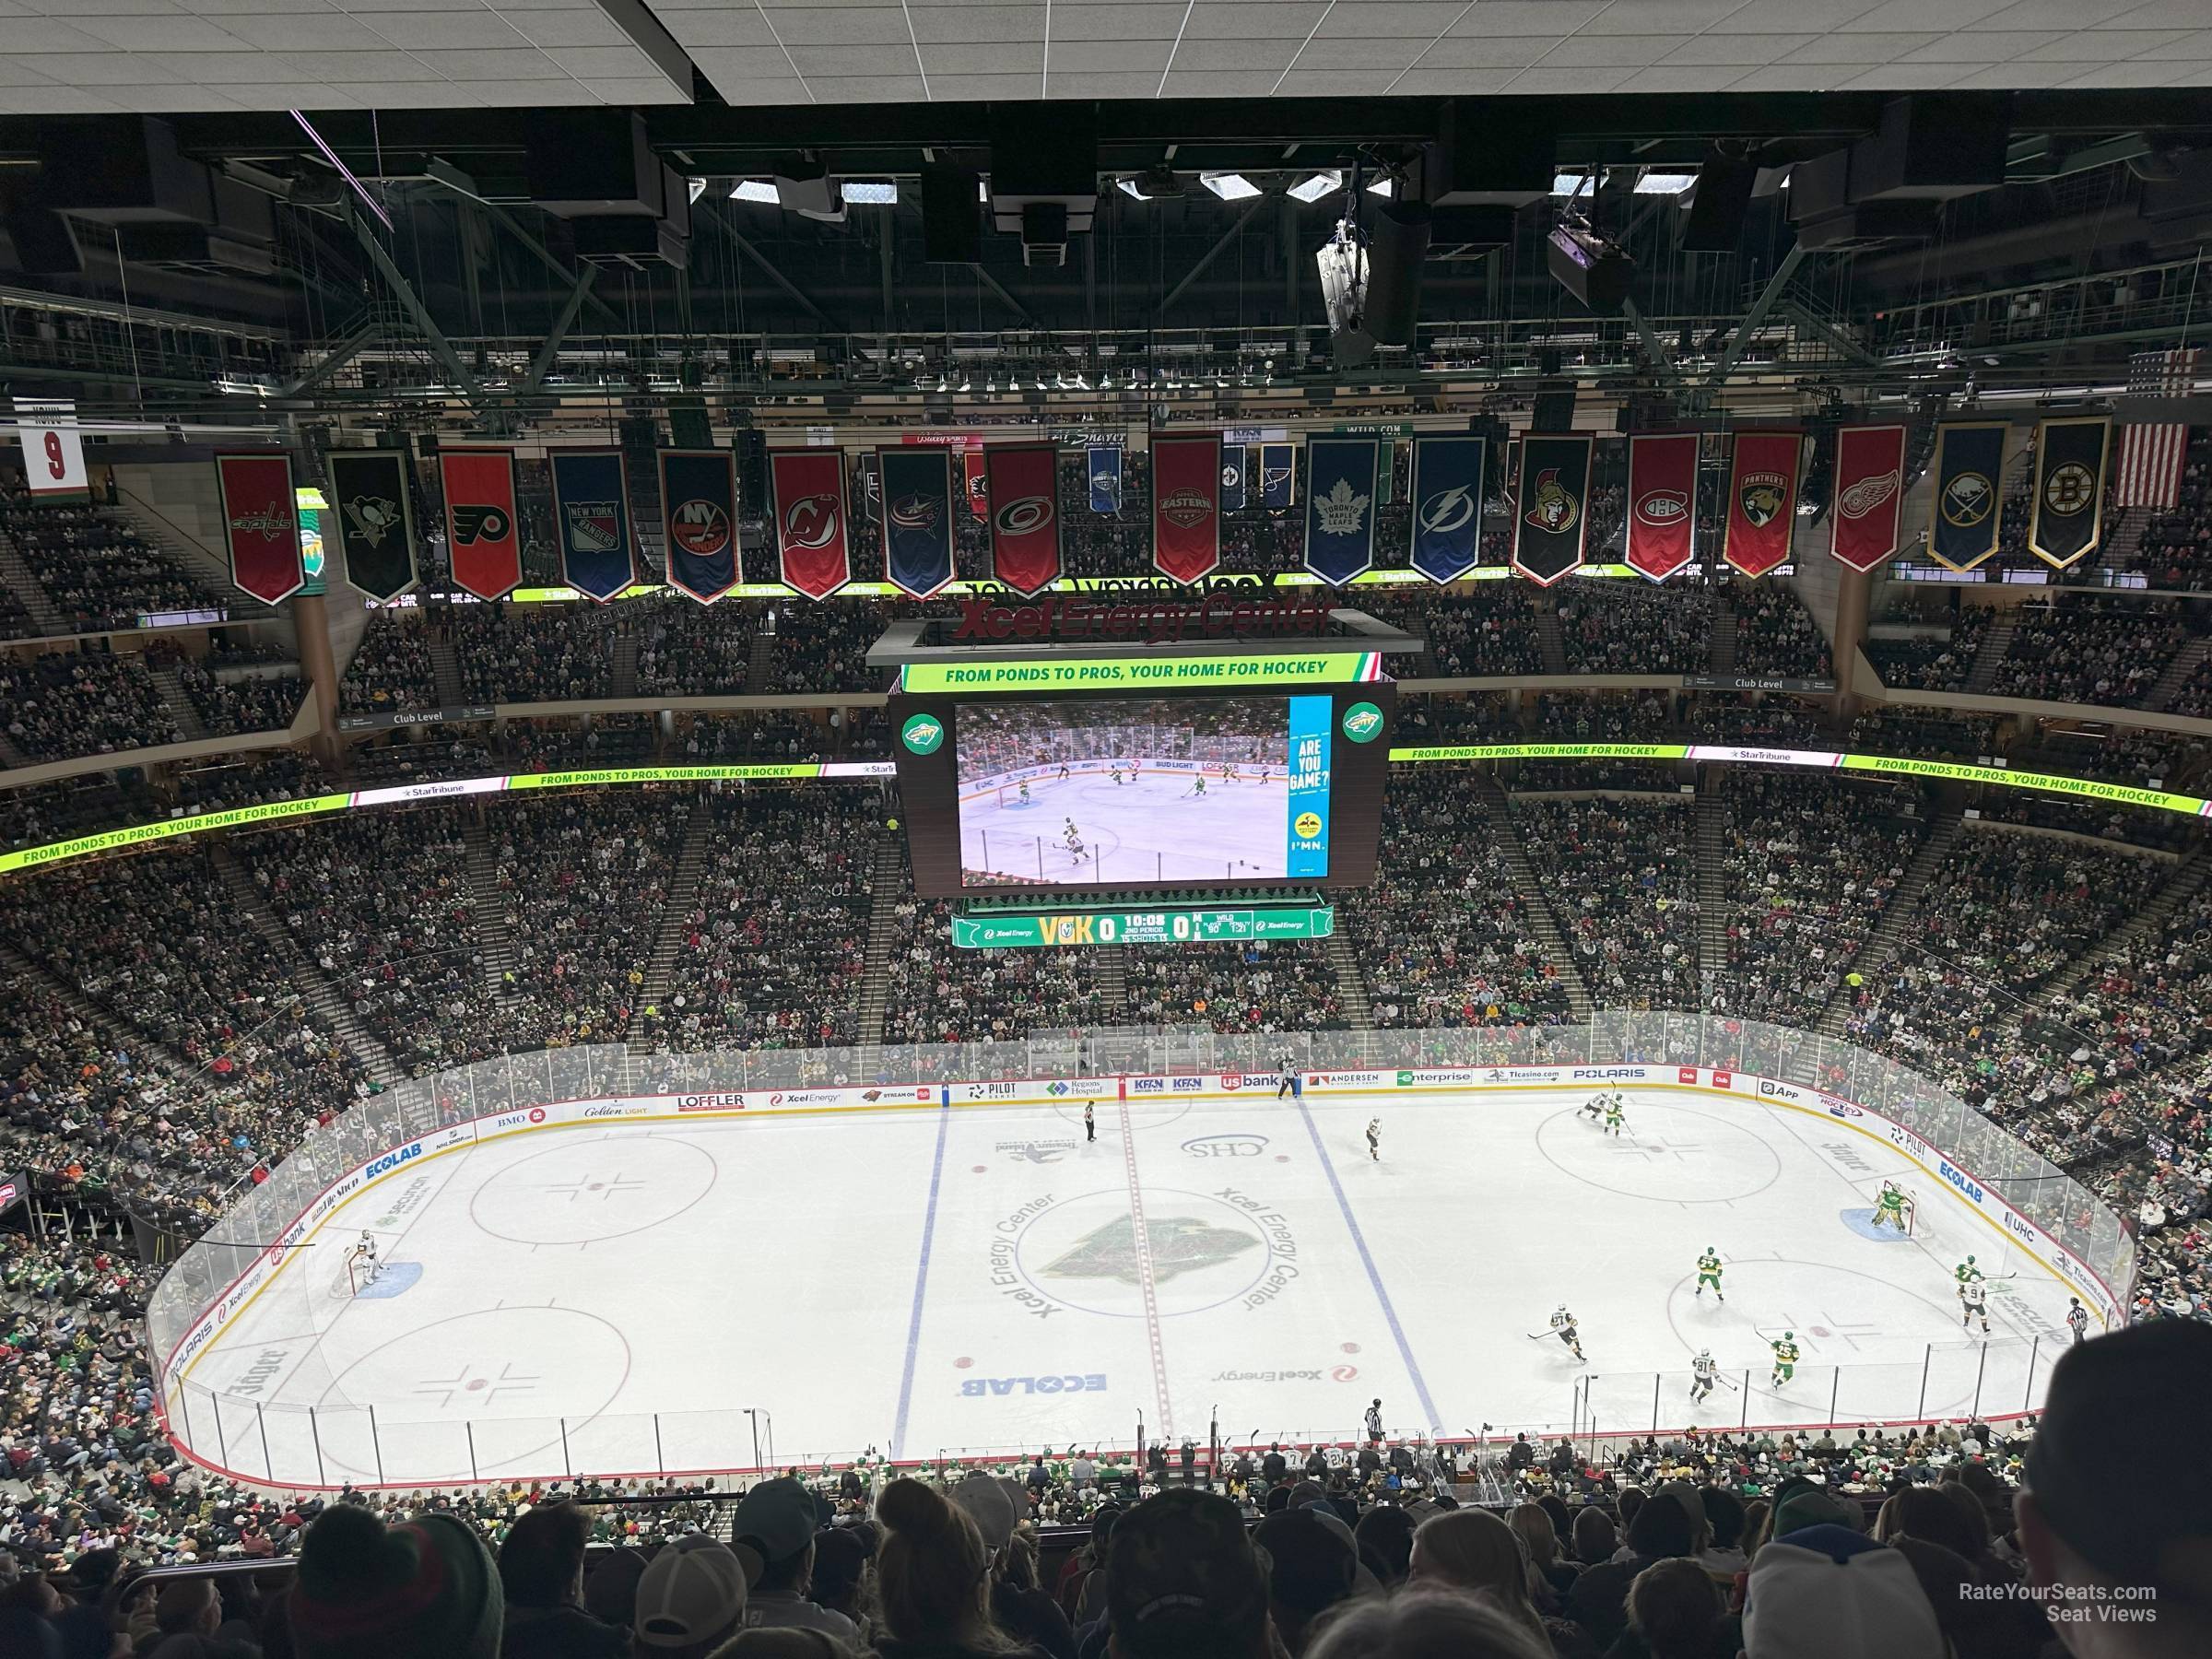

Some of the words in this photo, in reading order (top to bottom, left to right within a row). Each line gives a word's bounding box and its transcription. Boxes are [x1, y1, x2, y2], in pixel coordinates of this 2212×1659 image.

[44, 431, 65, 479] 9
[1744, 473, 1784, 487] PANTHERS
[571, 507, 589, 516] NEW
[592, 506, 613, 516] YORK
[1161, 498, 1211, 510] EASTERN
[1324, 505, 1359, 514] TORONTO
[578, 519, 617, 547] RANGERS
[953, 598, 1053, 638] Xcel
[1059, 596, 1198, 644] Energy
[1200, 593, 1338, 633] Center
[946, 669, 991, 682] FROM
[995, 667, 1050, 681] PONDS
[1054, 667, 1076, 679] TO
[1079, 666, 1124, 680] PROS,
[1130, 665, 1173, 677] YOUR
[1177, 664, 1225, 677] HOME
[1229, 663, 1259, 676] FOR
[1263, 661, 1328, 674] HOCKEY
[1735, 678, 1757, 688] Club
[1759, 678, 1783, 689] Level
[394, 714, 416, 726] Club
[418, 712, 442, 723] Level
[1299, 739, 1321, 758] ARE
[1412, 749, 1441, 758] FROM
[1443, 748, 1477, 758] PONDS
[1480, 747, 1492, 756] TO
[1495, 747, 1524, 756] PROS,
[1527, 747, 1555, 755] YOUR
[1558, 747, 1589, 755] HOME
[1591, 747, 1612, 755] FOR
[1614, 747, 1658, 756] HOCKEY
[1740, 750, 1790, 760] StarTribune
[1299, 756, 1321, 773] YOU
[541, 775, 571, 785] FROM
[575, 772, 611, 782] PONDS
[615, 771, 629, 781] TO
[631, 771, 662, 780] PROS,
[665, 770, 694, 778] YOUR
[696, 769, 727, 777] HOME
[730, 769, 749, 777] FOR
[751, 767, 794, 776] HOCKEY
[1290, 771, 1329, 791] GAME?
[1876, 759, 1910, 771] FROM
[1912, 763, 1953, 776] PONDS
[1957, 767, 1971, 777] TO
[1974, 770, 2010, 782] PROS,
[2014, 774, 2047, 787] YOUR
[2050, 779, 2088, 793] HOME
[2090, 785, 2114, 797] FOR
[2117, 790, 2170, 806] HOCKEY
[412, 785, 465, 796] StarTribune
[24, 847, 60, 864] FROM
[65, 837, 106, 855] PONDS
[110, 833, 125, 844] TO
[129, 826, 165, 841] PROS,
[168, 820, 202, 833] YOUR
[206, 812, 241, 826] HOME
[245, 807, 267, 820] FOR
[271, 800, 320, 816] HOCKEY
[1124, 914, 1165, 927] 10:08
[1173, 916, 1189, 938] 0
[1283, 922, 1305, 930] Energy
[1012, 929, 1034, 937] Energy
[1039, 916, 1094, 945] VGK
[1100, 919, 1115, 941] 0
[1132, 935, 1157, 943] SHOTS
[1398, 1070, 1471, 1083] enterprise
[1574, 1069, 1645, 1078] POLARIS
[1715, 1076, 1729, 1084] Cub
[989, 1083, 1016, 1094] PILOT
[1135, 1079, 1163, 1089] KFAN
[1173, 1077, 1202, 1088] KFAN
[1222, 1077, 1241, 1088] us
[1243, 1075, 1278, 1086] bank
[1071, 1086, 1102, 1095] Hospital
[678, 1095, 744, 1108] LOFFLER
[787, 1095, 808, 1103] Xcel
[809, 1093, 838, 1104] Energy
[584, 1105, 622, 1118] Golden
[626, 1107, 648, 1115] LIGHT
[1820, 1099, 1857, 1114] HOCKEY
[498, 1114, 525, 1127] BMO
[1190, 1143, 1263, 1158] CHS
[1907, 1134, 1926, 1156] PILOT
[366, 1144, 422, 1180] ECOLAB
[1940, 1161, 1983, 1204] ECOLAB
[1213, 1187, 1271, 1213] Xcel
[996, 1194, 1055, 1233] Center
[284, 1221, 306, 1251] bank
[2014, 1218, 2035, 1241] UHC
[1260, 1213, 1299, 1263] Energy
[991, 1236, 1018, 1287] Energy
[1962, 1269, 1971, 1279] 7
[229, 1287, 244, 1310] Xcel
[243, 1272, 263, 1294] Energy
[1241, 1264, 1300, 1312] Center
[1971, 1288, 1978, 1299] 9
[1003, 1287, 1063, 1319] Xcel
[1698, 1360, 1708, 1373] 81
[1217, 1370, 1277, 1382] Energy
[1278, 1370, 1323, 1381] Xcel
[961, 1374, 1106, 1396] ECOLAB
